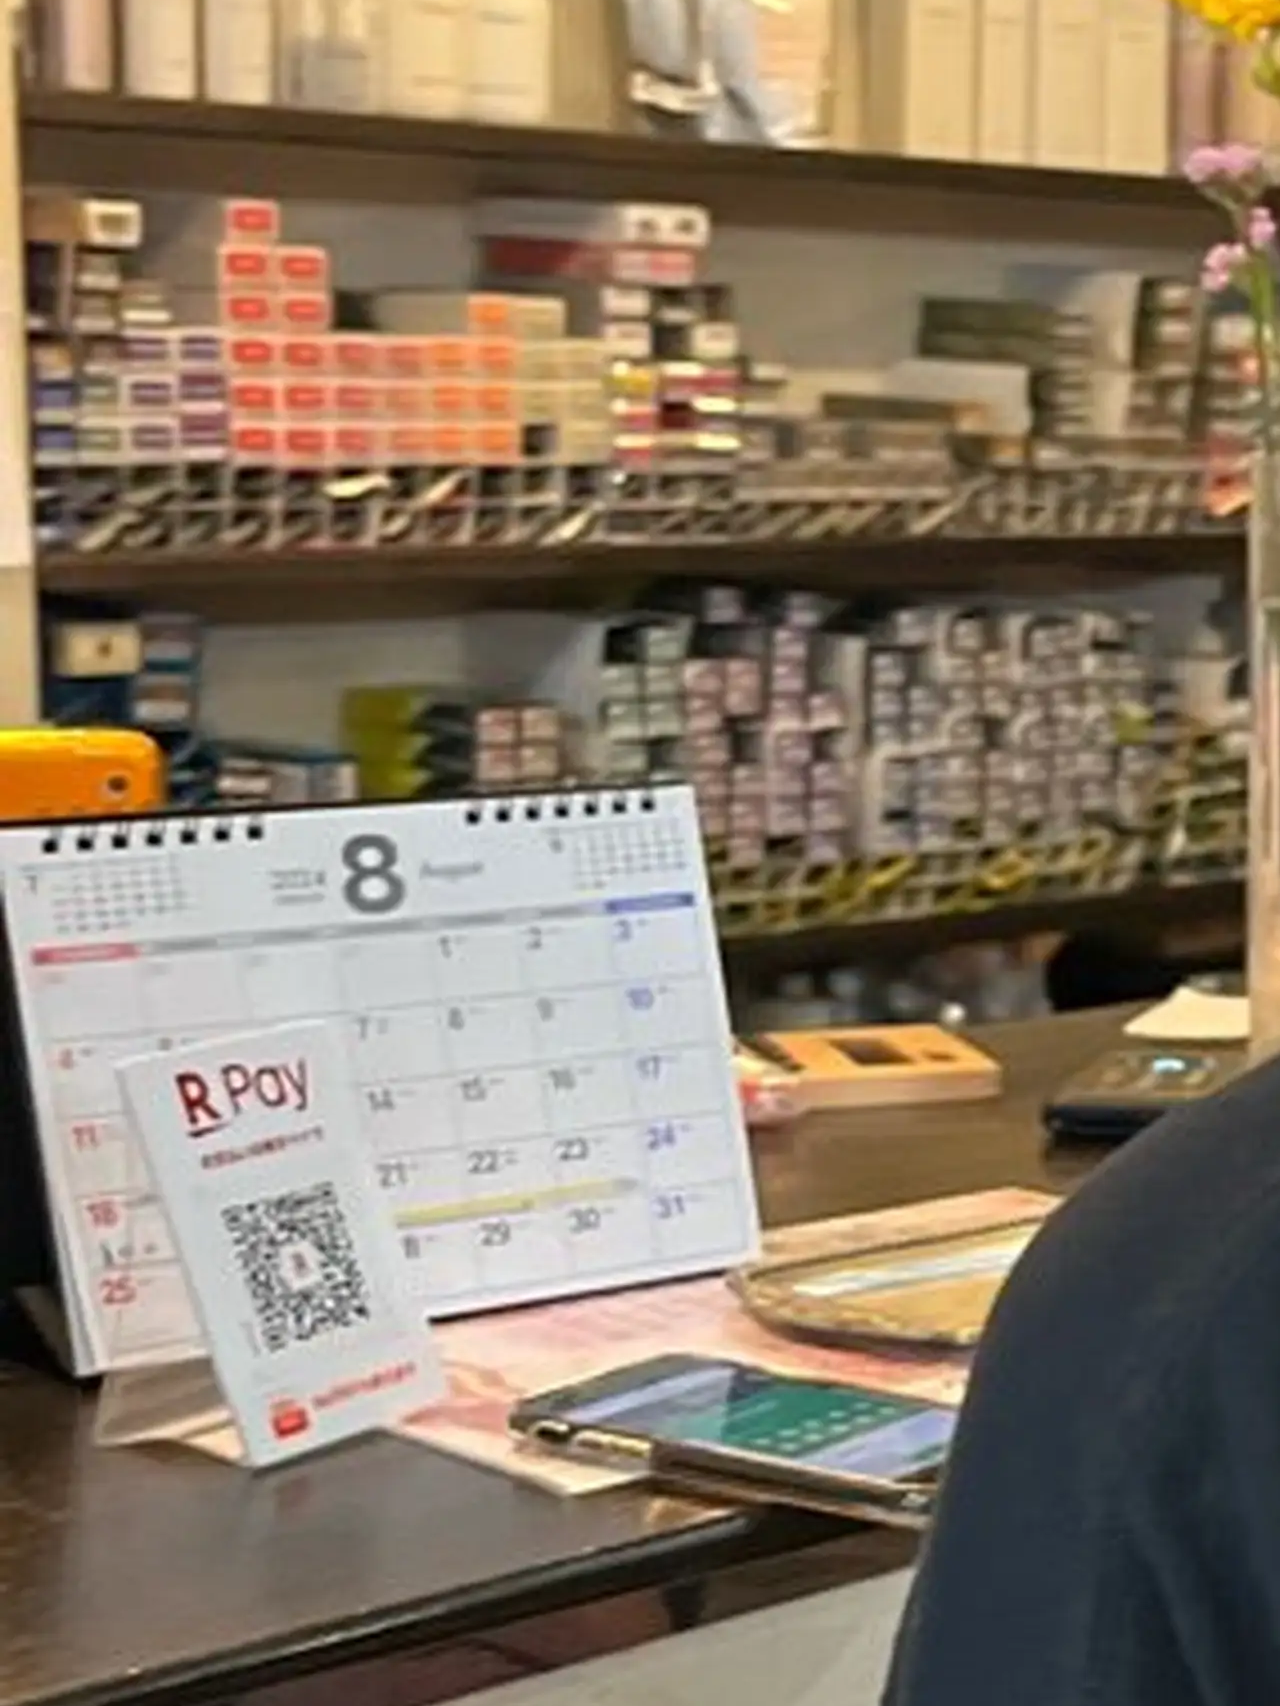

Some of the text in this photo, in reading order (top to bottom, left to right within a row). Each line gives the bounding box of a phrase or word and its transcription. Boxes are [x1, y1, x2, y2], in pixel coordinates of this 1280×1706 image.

[341, 833, 406, 915] 8
[175, 1056, 309, 1139] R Pay
[376, 1161, 409, 1189] 21
[467, 1148, 499, 1175] 22
[554, 1136, 591, 1163] 23
[101, 1272, 138, 1305] 25
[480, 1219, 512, 1247] 29
[569, 1206, 601, 1234] 30
